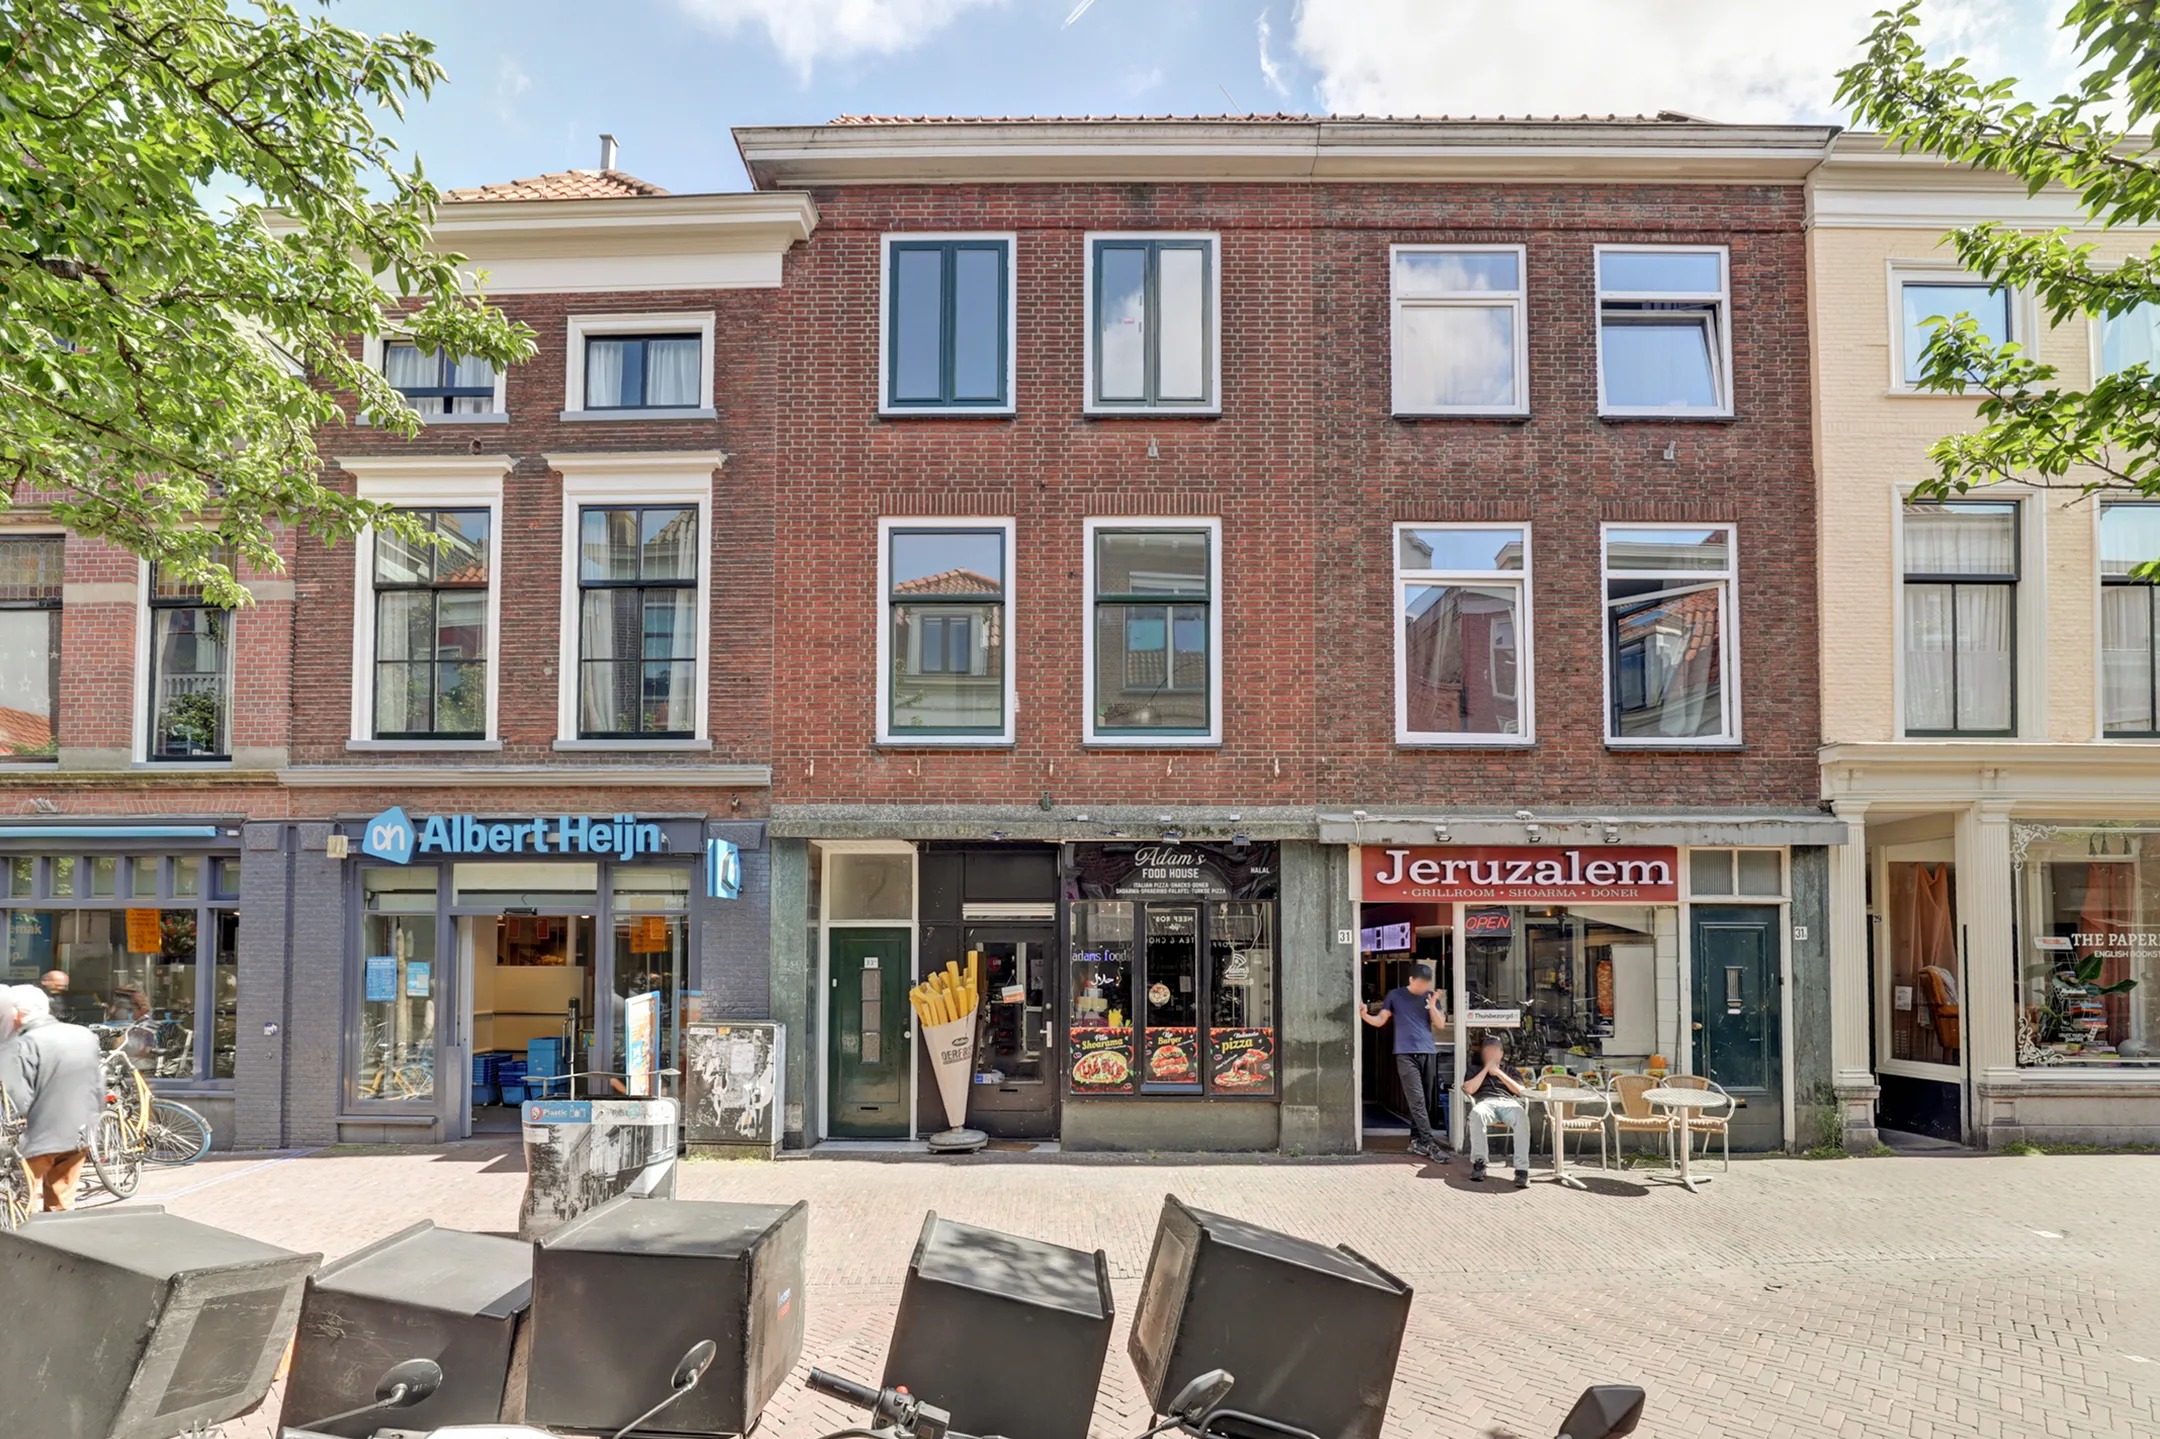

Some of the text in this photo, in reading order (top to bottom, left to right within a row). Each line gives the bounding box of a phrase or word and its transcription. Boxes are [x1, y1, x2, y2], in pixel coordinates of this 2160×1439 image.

[418, 813, 663, 861] Albert Heijn
[1134, 846, 1207, 867] Adam's
[1142, 868, 1200, 879] FOOD HOUSE
[1375, 849, 1674, 886] Jeruzalem
[1411, 888, 1495, 897] GRILLROOM
[1509, 888, 1577, 897] SHOARMA
[1465, 915, 1511, 931] OPEN
[1339, 932, 1351, 943] 31
[2071, 933, 2104, 946] THE
[2108, 933, 2160, 947] PAPER
[1072, 950, 1101, 961] adams
[2094, 950, 2128, 958] ENGLISH
[1090, 973, 1115, 986] حلال
[1158, 1036, 1182, 1045] Burger
[1221, 1036, 1254, 1054] pizza
[543, 1106, 568, 1117] Plastic
